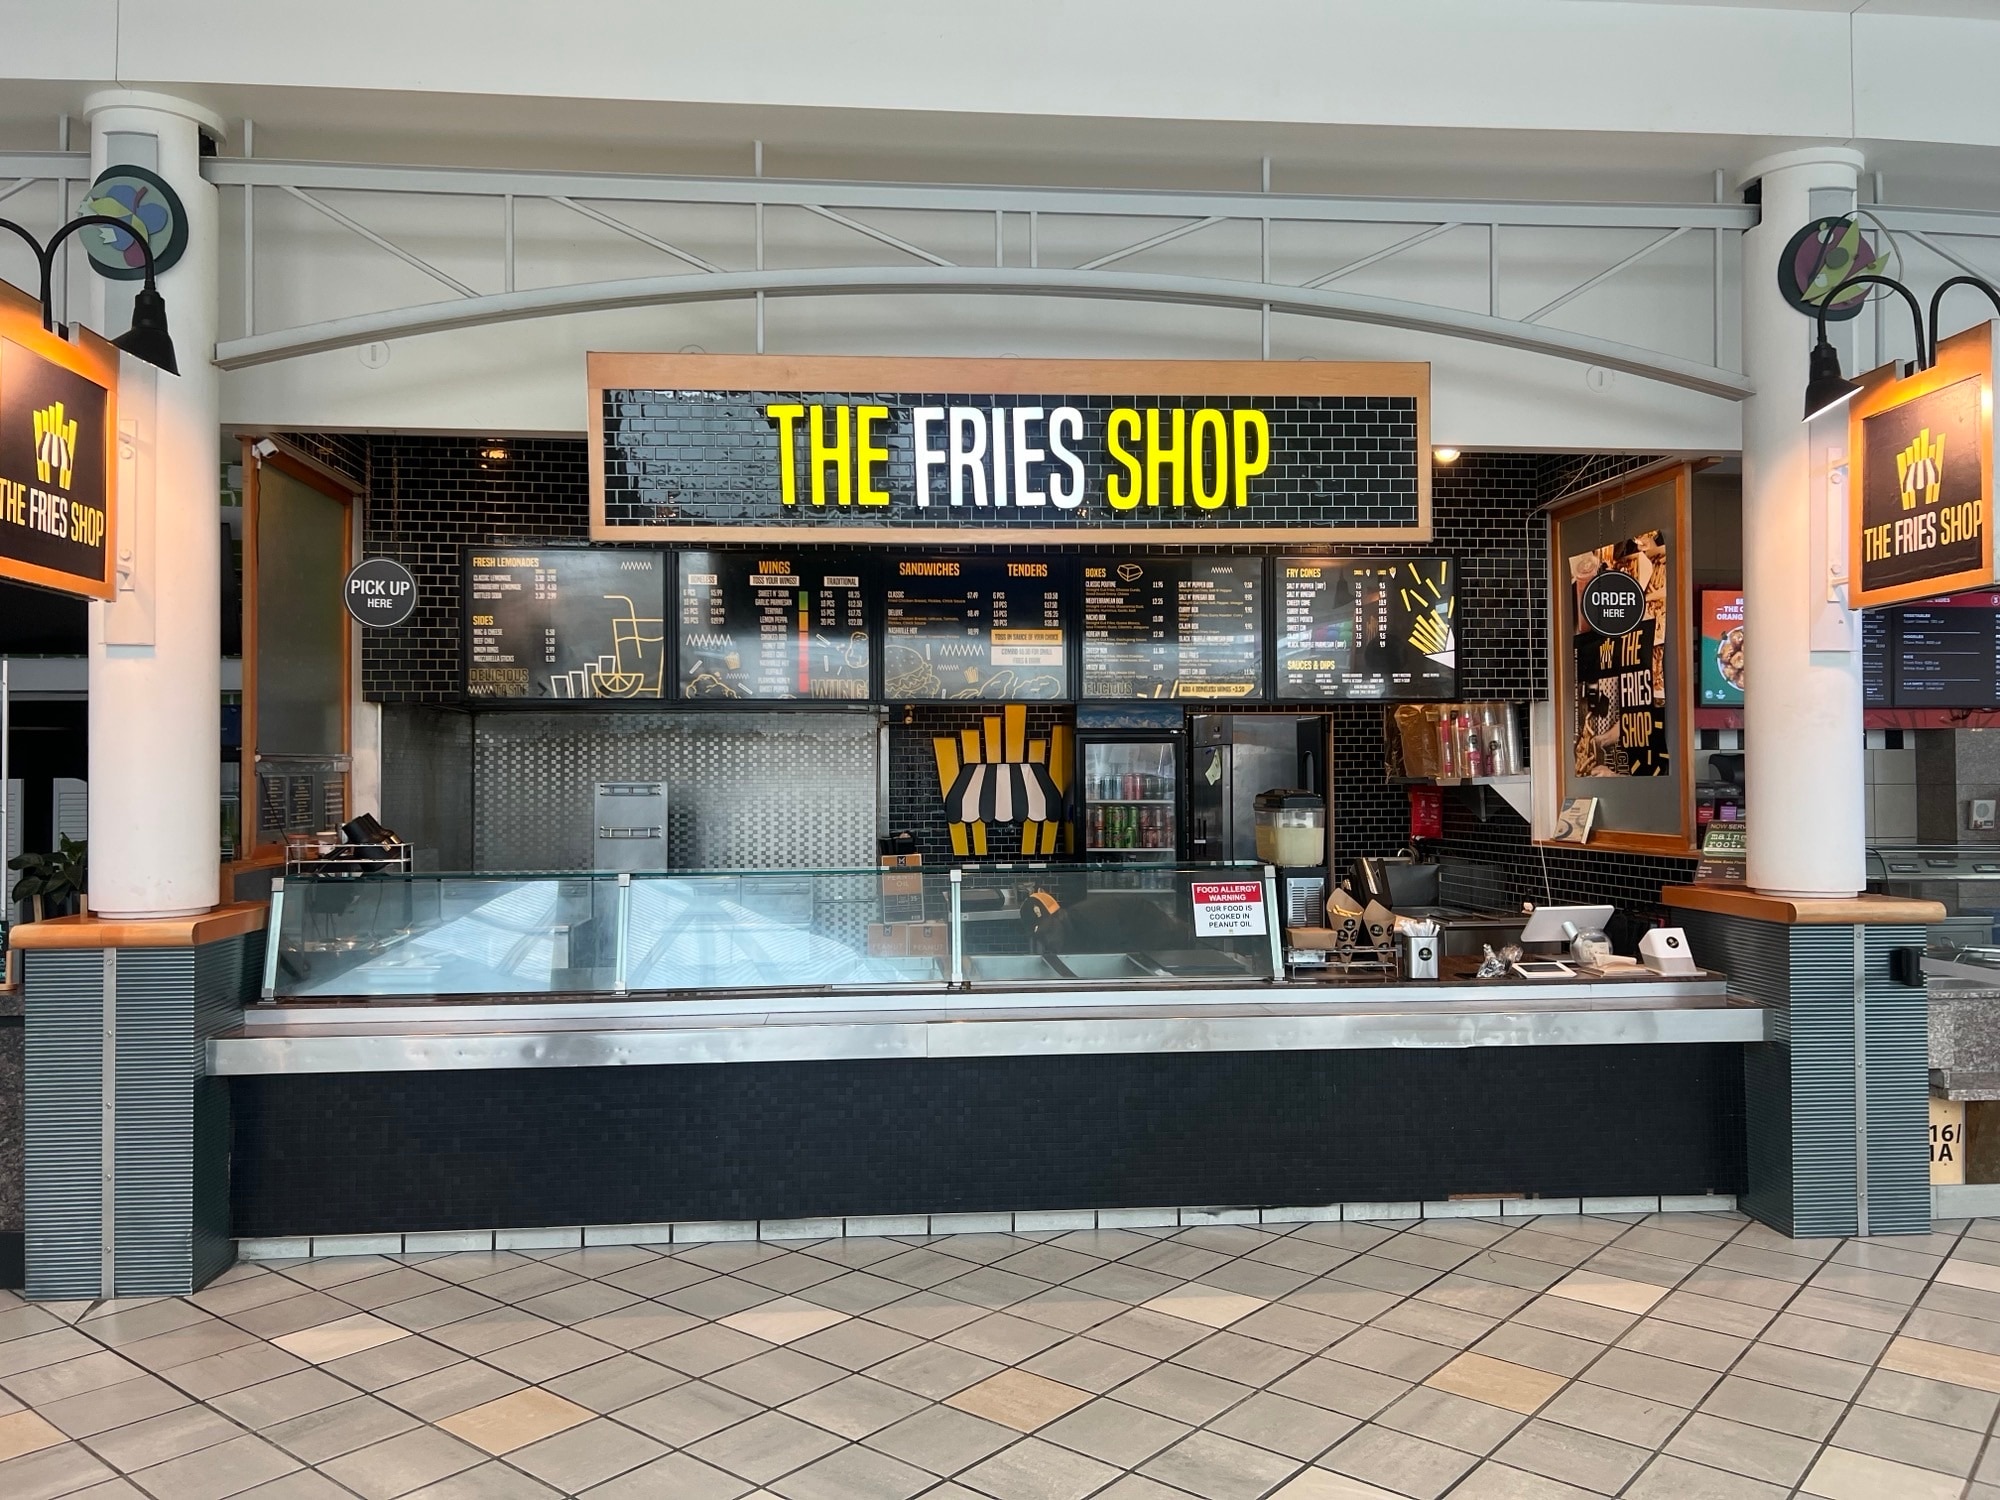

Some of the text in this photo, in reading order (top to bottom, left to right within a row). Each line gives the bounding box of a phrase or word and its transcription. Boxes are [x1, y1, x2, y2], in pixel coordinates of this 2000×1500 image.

[766, 404, 1270, 510] THE FRIES SHOP
[0, 477, 104, 547] THE FRIES SHOP
[1864, 500, 1982, 562] THE FRIES SHOP
[473, 557, 539, 567] FRESH LEMONADES
[758, 561, 791, 574] WINGS
[899, 562, 960, 577] SANDWICHES
[1007, 563, 1048, 577] TENDERS
[1085, 568, 1106, 578] BOXES
[1286, 568, 1321, 578] FRY CONES
[351, 580, 410, 596] PICK UP
[367, 598, 393, 608] HERE
[1592, 592, 1636, 606] ORDER
[472, 615, 494, 625] SIDES
[1603, 609, 1625, 618] HERE
[1621, 630, 1643, 667] THE
[1287, 660, 1336, 670] SAUCES & DIPS
[469, 668, 530, 682] DELICIOUS
[810, 679, 869, 699] WING
[1083, 682, 1132, 695] ELICIOUS
[1620, 669, 1652, 708] FRIES
[1622, 711, 1652, 748] SHOP
